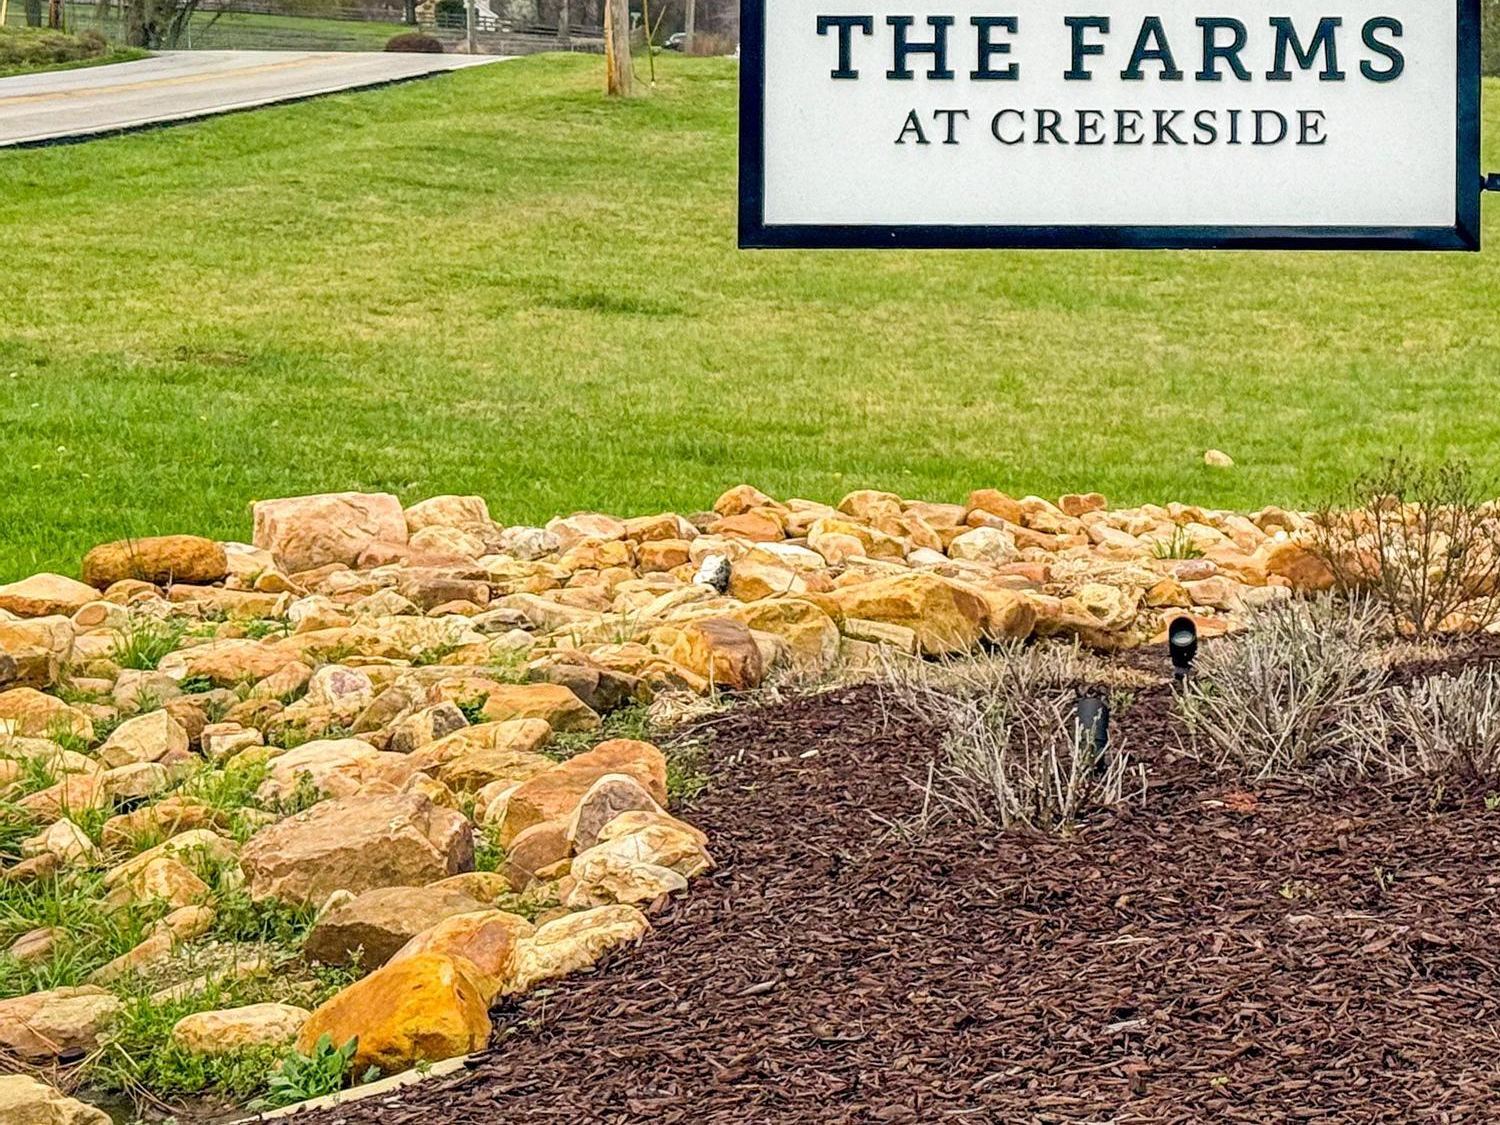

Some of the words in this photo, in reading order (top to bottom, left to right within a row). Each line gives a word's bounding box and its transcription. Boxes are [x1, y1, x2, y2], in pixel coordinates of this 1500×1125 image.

[816, 15, 1019, 81] THE
[1062, 15, 1406, 83] FARMS
[893, 108, 970, 145] AT
[990, 108, 1327, 146] CREEKSIDE
